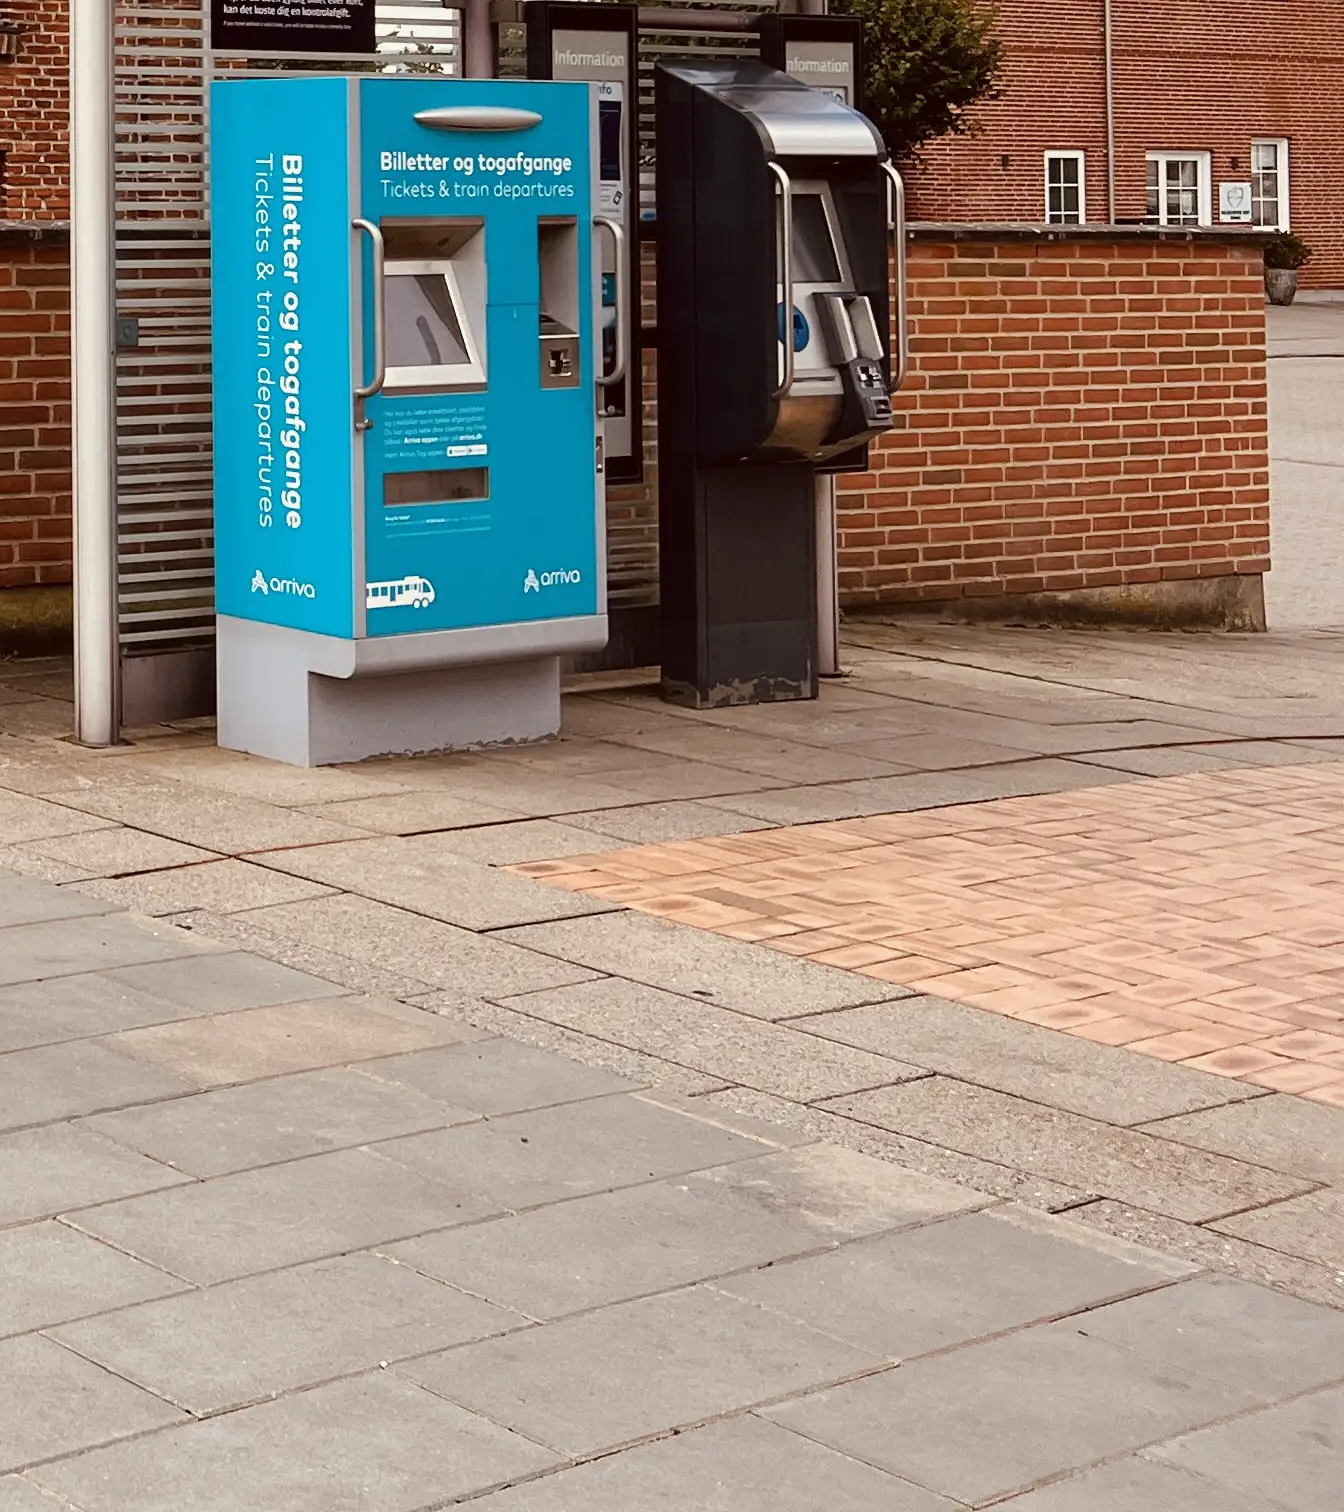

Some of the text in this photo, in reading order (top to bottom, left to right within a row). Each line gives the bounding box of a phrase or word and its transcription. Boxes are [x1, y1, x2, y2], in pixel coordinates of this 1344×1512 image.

[223, 4, 238, 14] kan
[239, 5, 253, 15] det
[254, 5, 276, 16] koste
[276, 6, 290, 17] dig
[290, 8, 301, 16] en
[554, 49, 625, 68] Information
[786, 56, 849, 74] nformation
[380, 151, 572, 176] Billetter og togafgange
[380, 179, 574, 200] Tickets & train departures
[253, 153, 276, 528] Tickets & train departures
[279, 154, 306, 529] Billetter og togafgange
[540, 568, 581, 586] arriva
[269, 577, 316, 599] arriva
